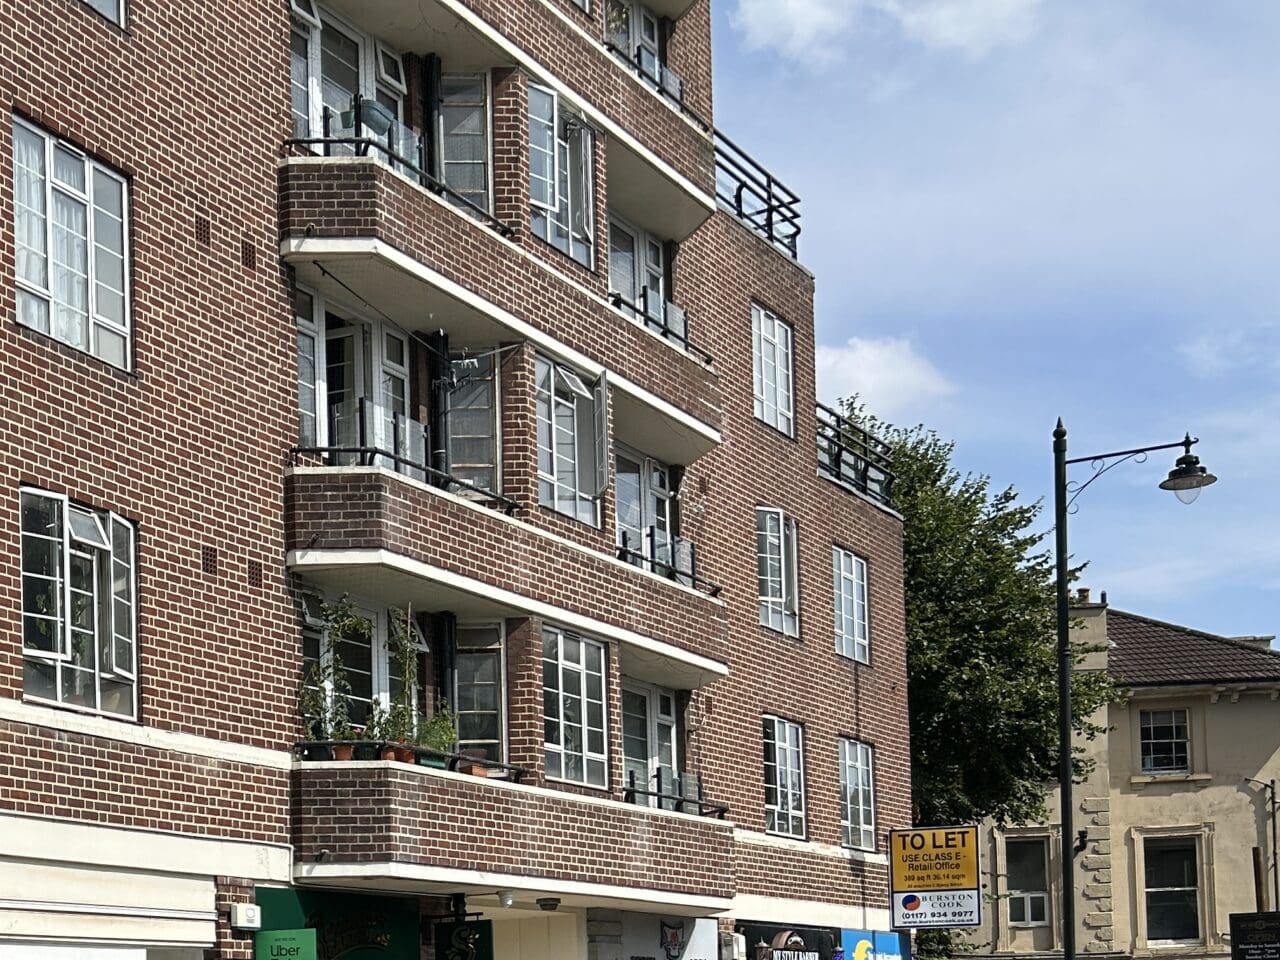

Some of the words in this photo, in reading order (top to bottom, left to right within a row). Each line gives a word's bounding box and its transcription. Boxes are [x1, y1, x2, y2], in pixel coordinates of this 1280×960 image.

[898, 833, 925, 850] TO
[932, 831, 969, 849] LET
[902, 854, 920, 862] USE
[922, 852, 952, 862] CLASS
[955, 852, 961, 860] E
[901, 912, 927, 920] (0117)
[270, 945, 301, 957] Uber
